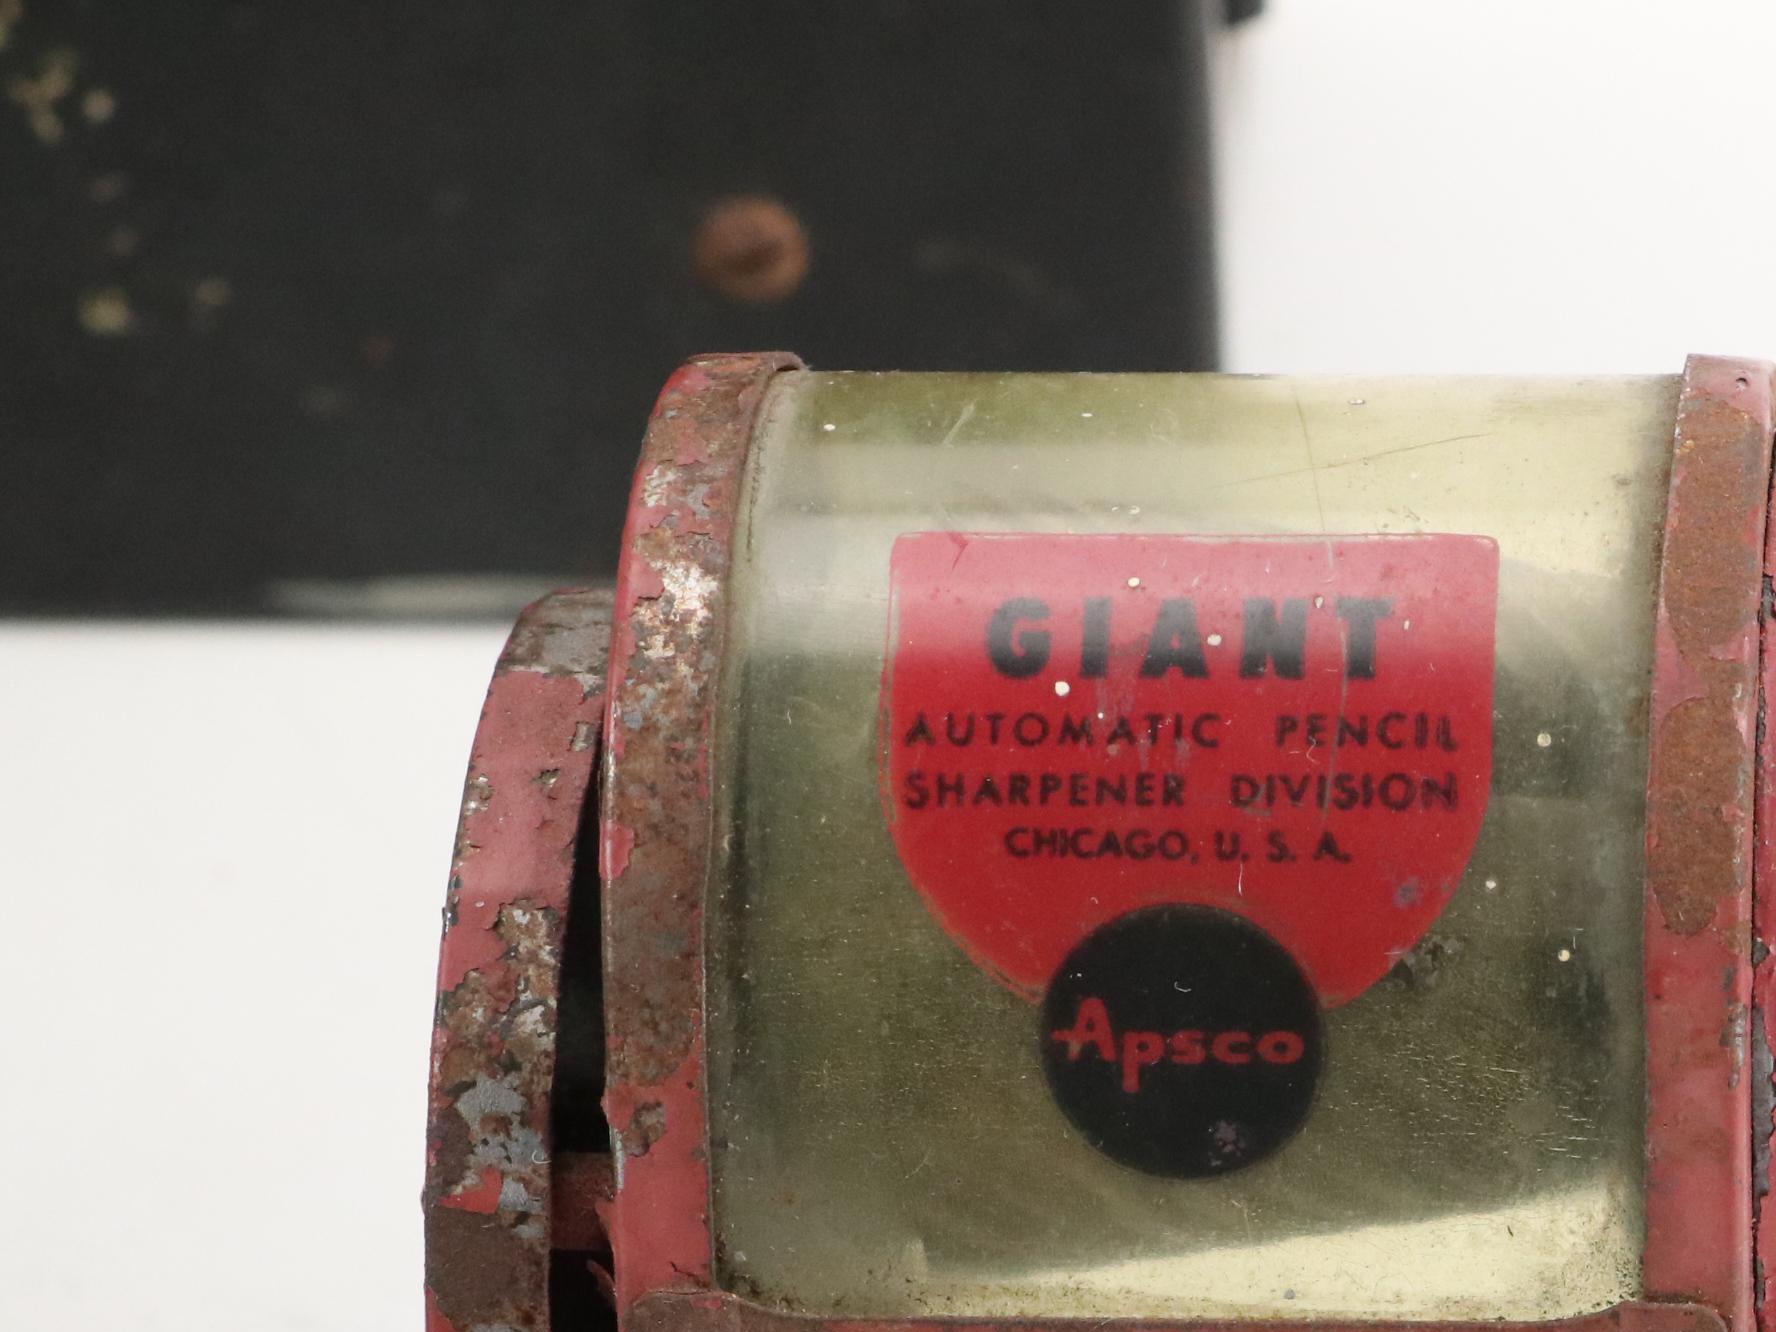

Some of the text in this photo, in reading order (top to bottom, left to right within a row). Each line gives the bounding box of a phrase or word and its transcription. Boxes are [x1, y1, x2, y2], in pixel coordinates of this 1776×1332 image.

[986, 597, 1394, 679] GIANT
[905, 711, 1459, 752] AUTOMATIC PENCIL
[904, 771, 1459, 812] SHARPENER DIVISION
[1004, 827, 1199, 865] CHICAGO,
[1051, 997, 1305, 1093] Apsco
